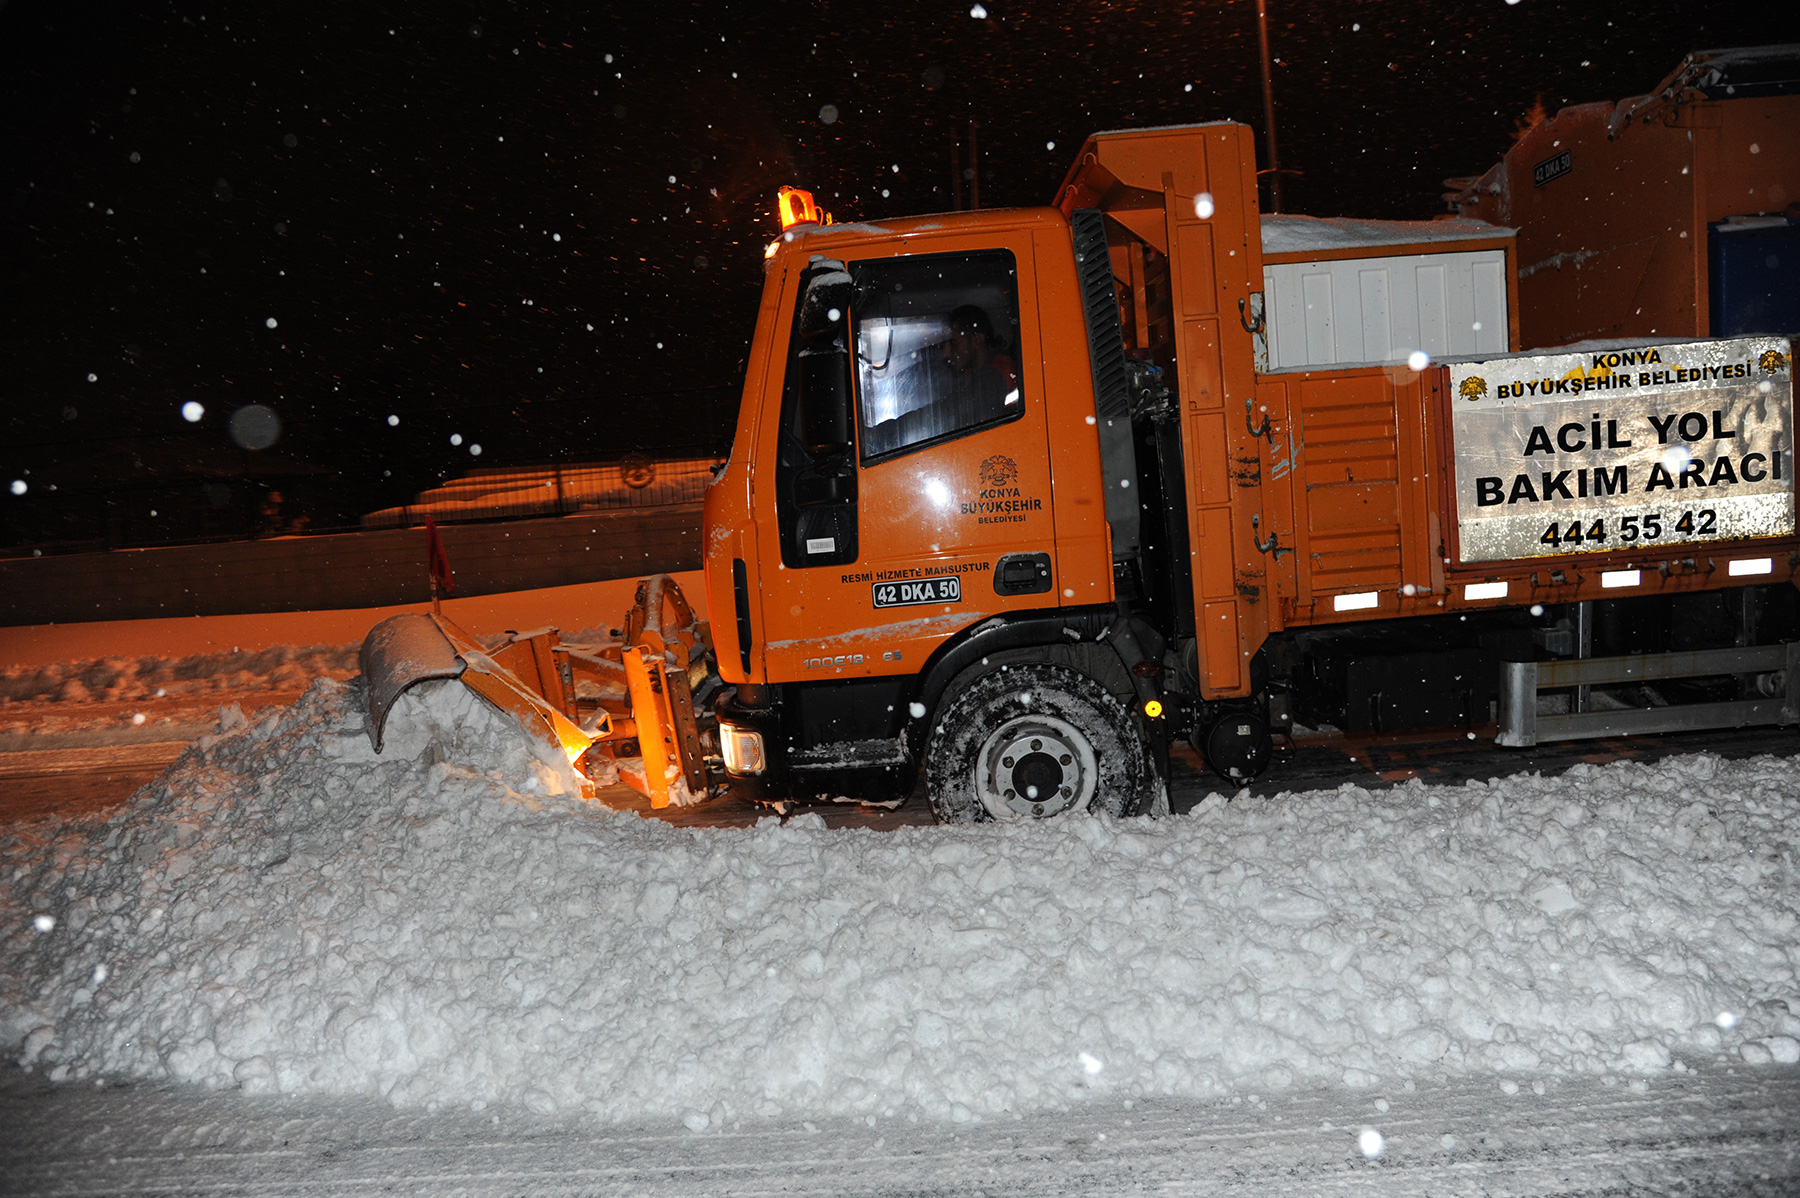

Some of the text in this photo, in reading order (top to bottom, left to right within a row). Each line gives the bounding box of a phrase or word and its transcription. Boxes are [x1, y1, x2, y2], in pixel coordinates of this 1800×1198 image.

[1592, 349, 1662, 369] KONYA
[1497, 360, 1752, 399] BÜYÜKŞEHİR BELEDİYESİ
[1523, 410, 1736, 456] ACİL YOL
[1476, 451, 1782, 507] BAKIM ARACI
[980, 488, 1021, 499] KONYA
[961, 497, 1042, 515] BÜYÜKŞEHİR
[978, 513, 1026, 524] BELEDİYESİ
[1540, 509, 1718, 548] 444 55 42
[841, 562, 990, 583] RESMİ HİZMETE MAHSUSTUR
[877, 580, 958, 602] 42 DKA 50
[803, 654, 864, 669] 100E18
